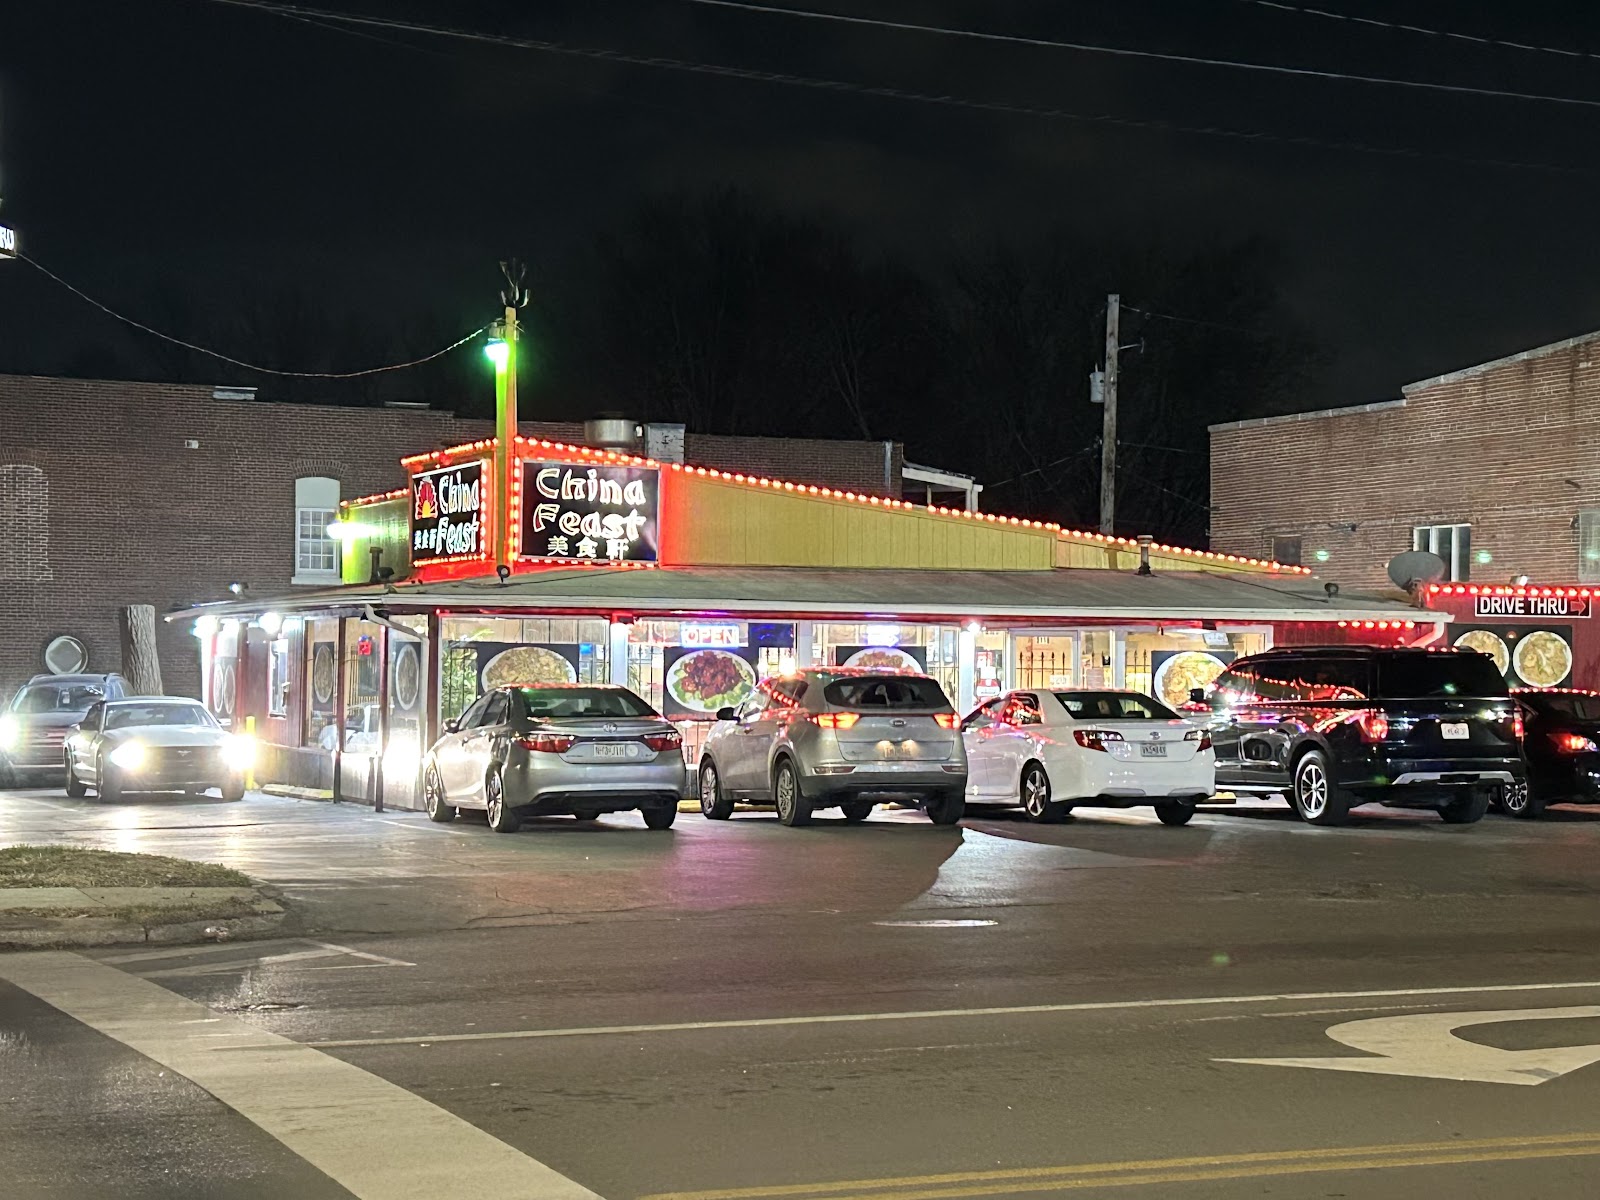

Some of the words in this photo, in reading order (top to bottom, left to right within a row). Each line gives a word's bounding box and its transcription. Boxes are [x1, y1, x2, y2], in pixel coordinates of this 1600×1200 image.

[439, 471, 480, 514] China
[536, 468, 646, 505] China
[435, 512, 480, 555] Feast
[533, 503, 647, 542] Feast
[1480, 597, 1525, 614] DRIVE
[1528, 597, 1567, 614] THRU
[684, 628, 737, 644] OPEN
